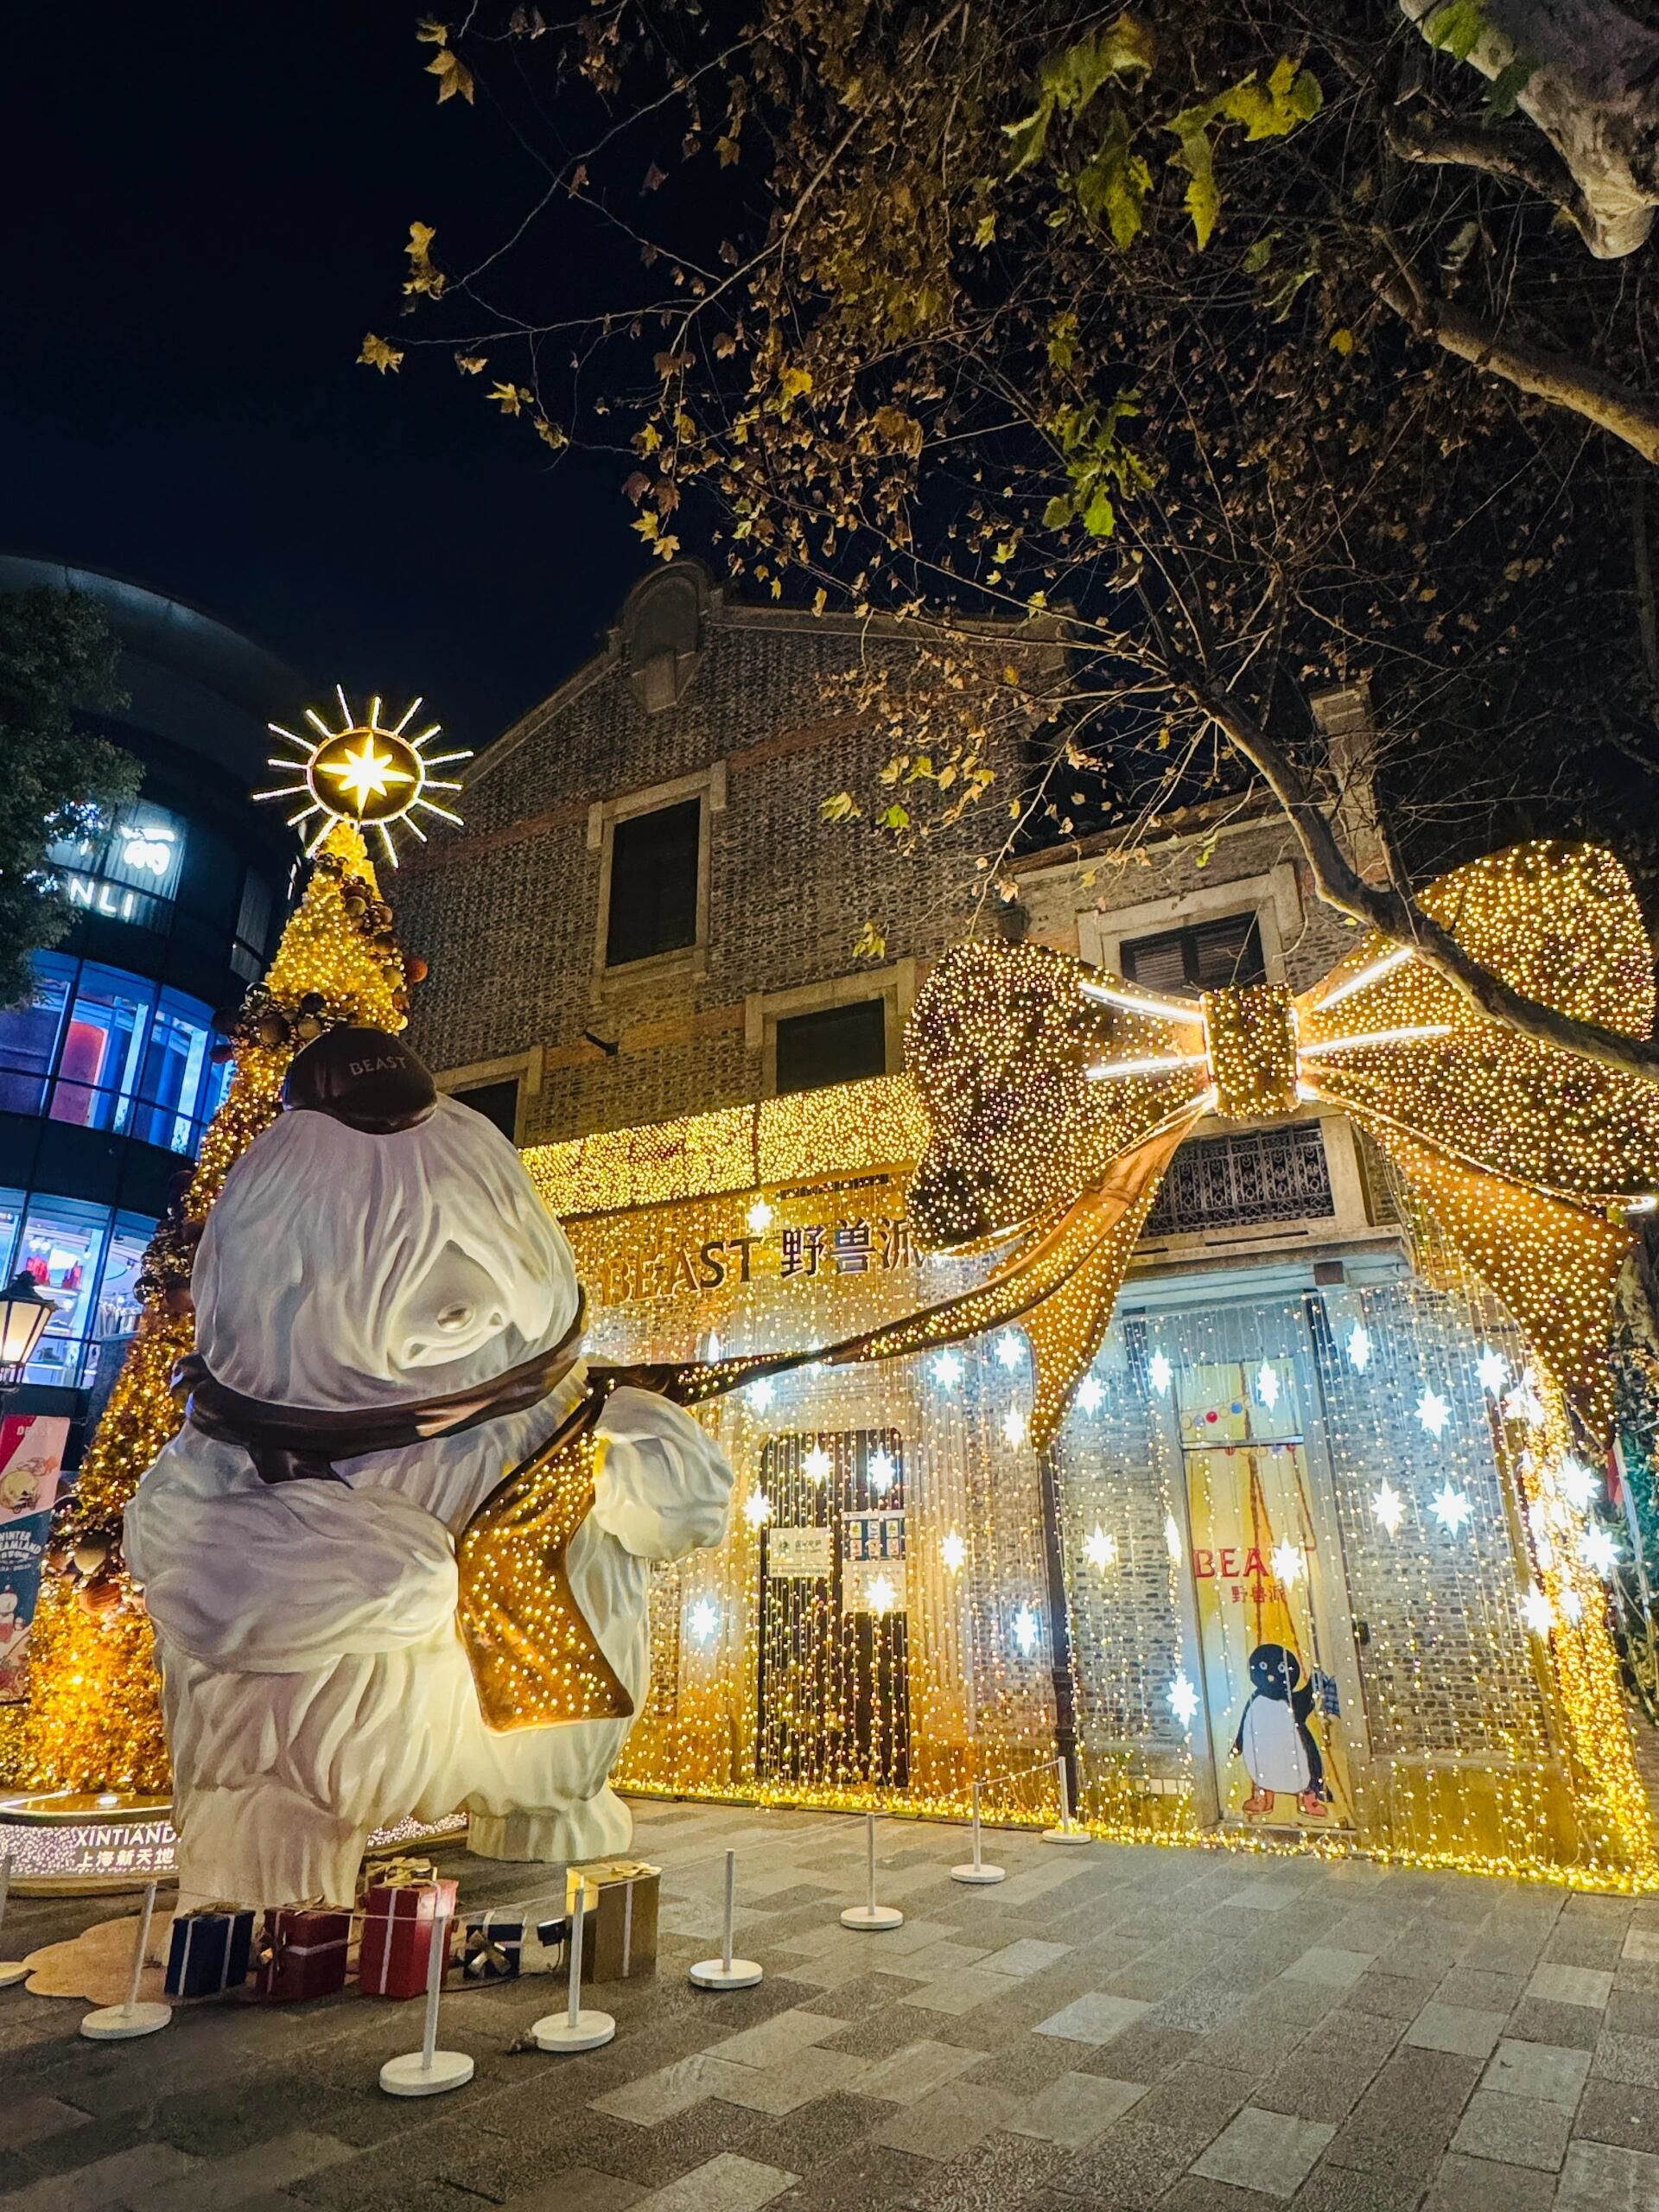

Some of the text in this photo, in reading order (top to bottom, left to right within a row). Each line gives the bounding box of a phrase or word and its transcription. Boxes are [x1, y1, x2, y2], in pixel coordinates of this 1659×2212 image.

[349, 1056, 406, 1076] BEAST
[780, 1218, 923, 1279] 野兽派
[601, 1236, 764, 1304] BEAST
[1192, 1548, 1271, 1578] BEA
[75, 1825, 181, 1847] XINTIAND
[77, 1847, 175, 1868] 上海新天地
